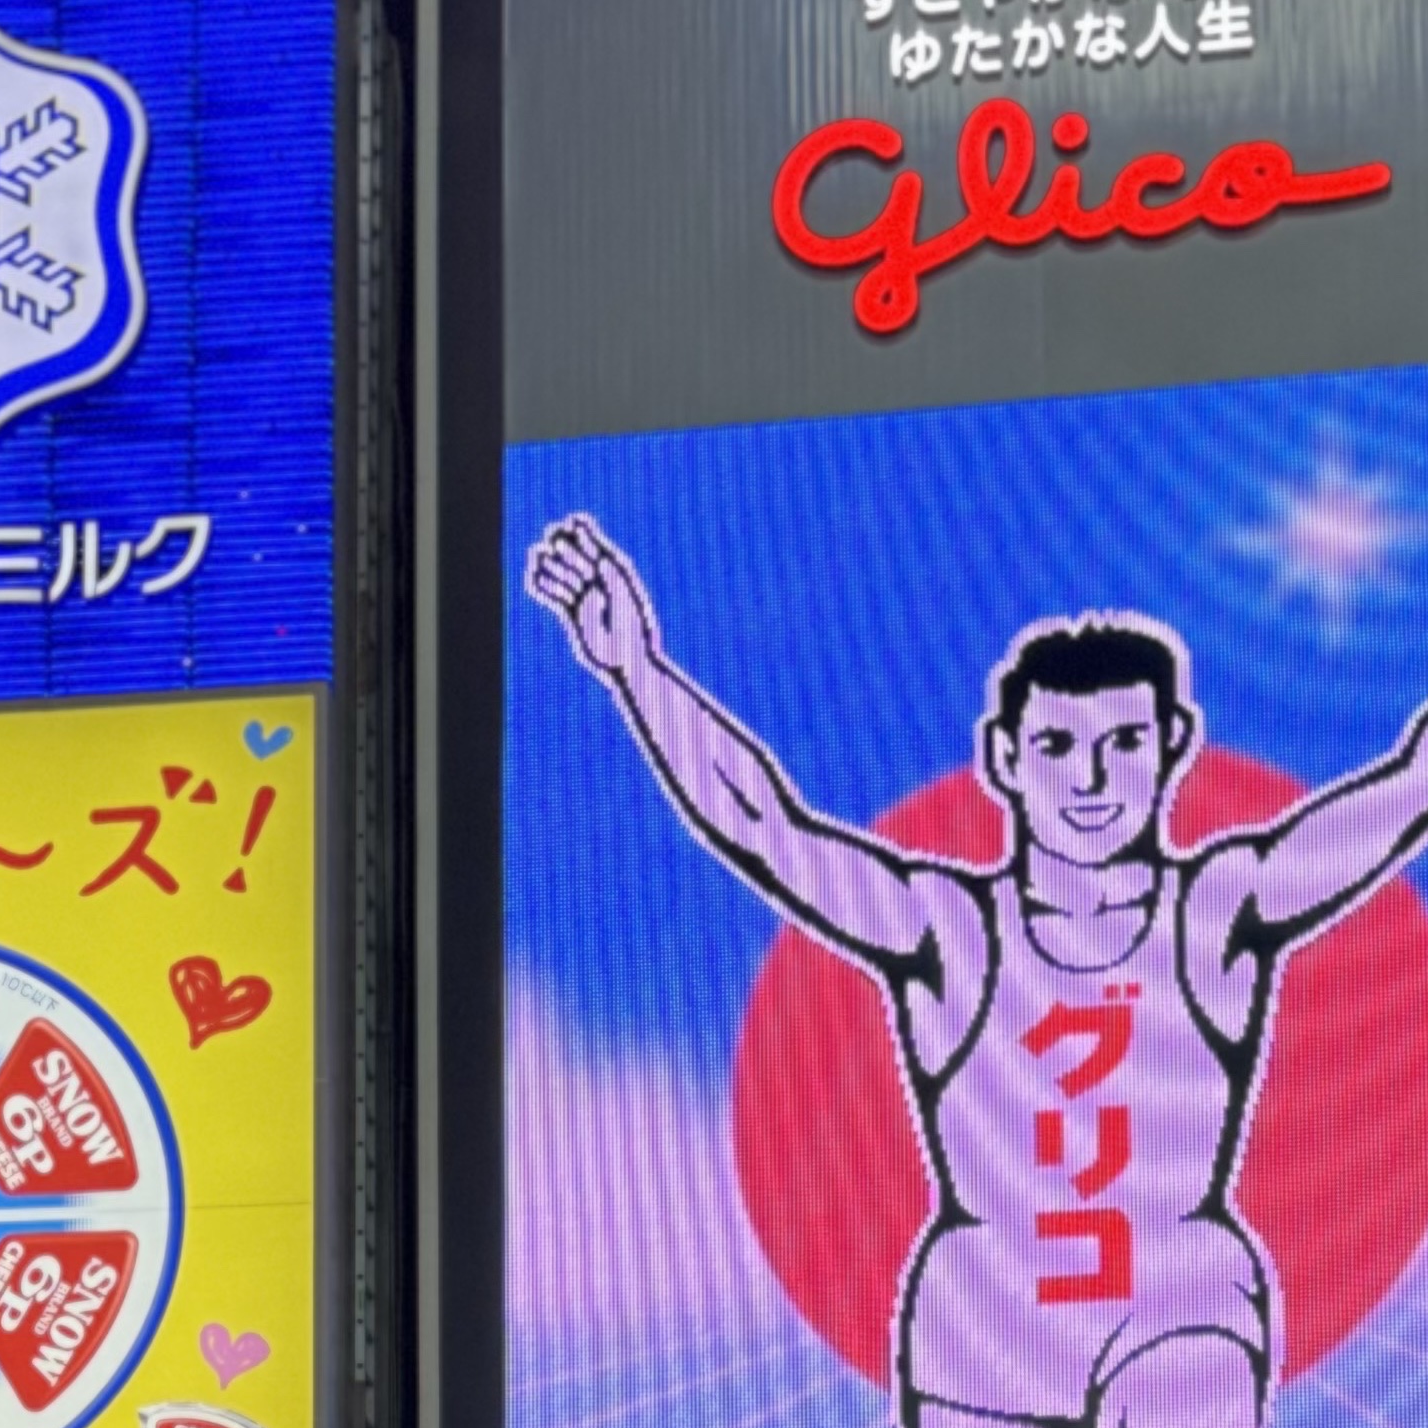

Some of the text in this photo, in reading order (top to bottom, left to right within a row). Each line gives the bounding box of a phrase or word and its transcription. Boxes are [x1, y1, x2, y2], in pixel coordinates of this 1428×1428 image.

[889, 0, 1255, 81] ゆたかな人生
[31, 1049, 124, 1166] SNOW
[36, 1095, 75, 1149] BRAND
[1019, 981, 1142, 1306] グリコ
[31, 1257, 120, 1387] SNOW
